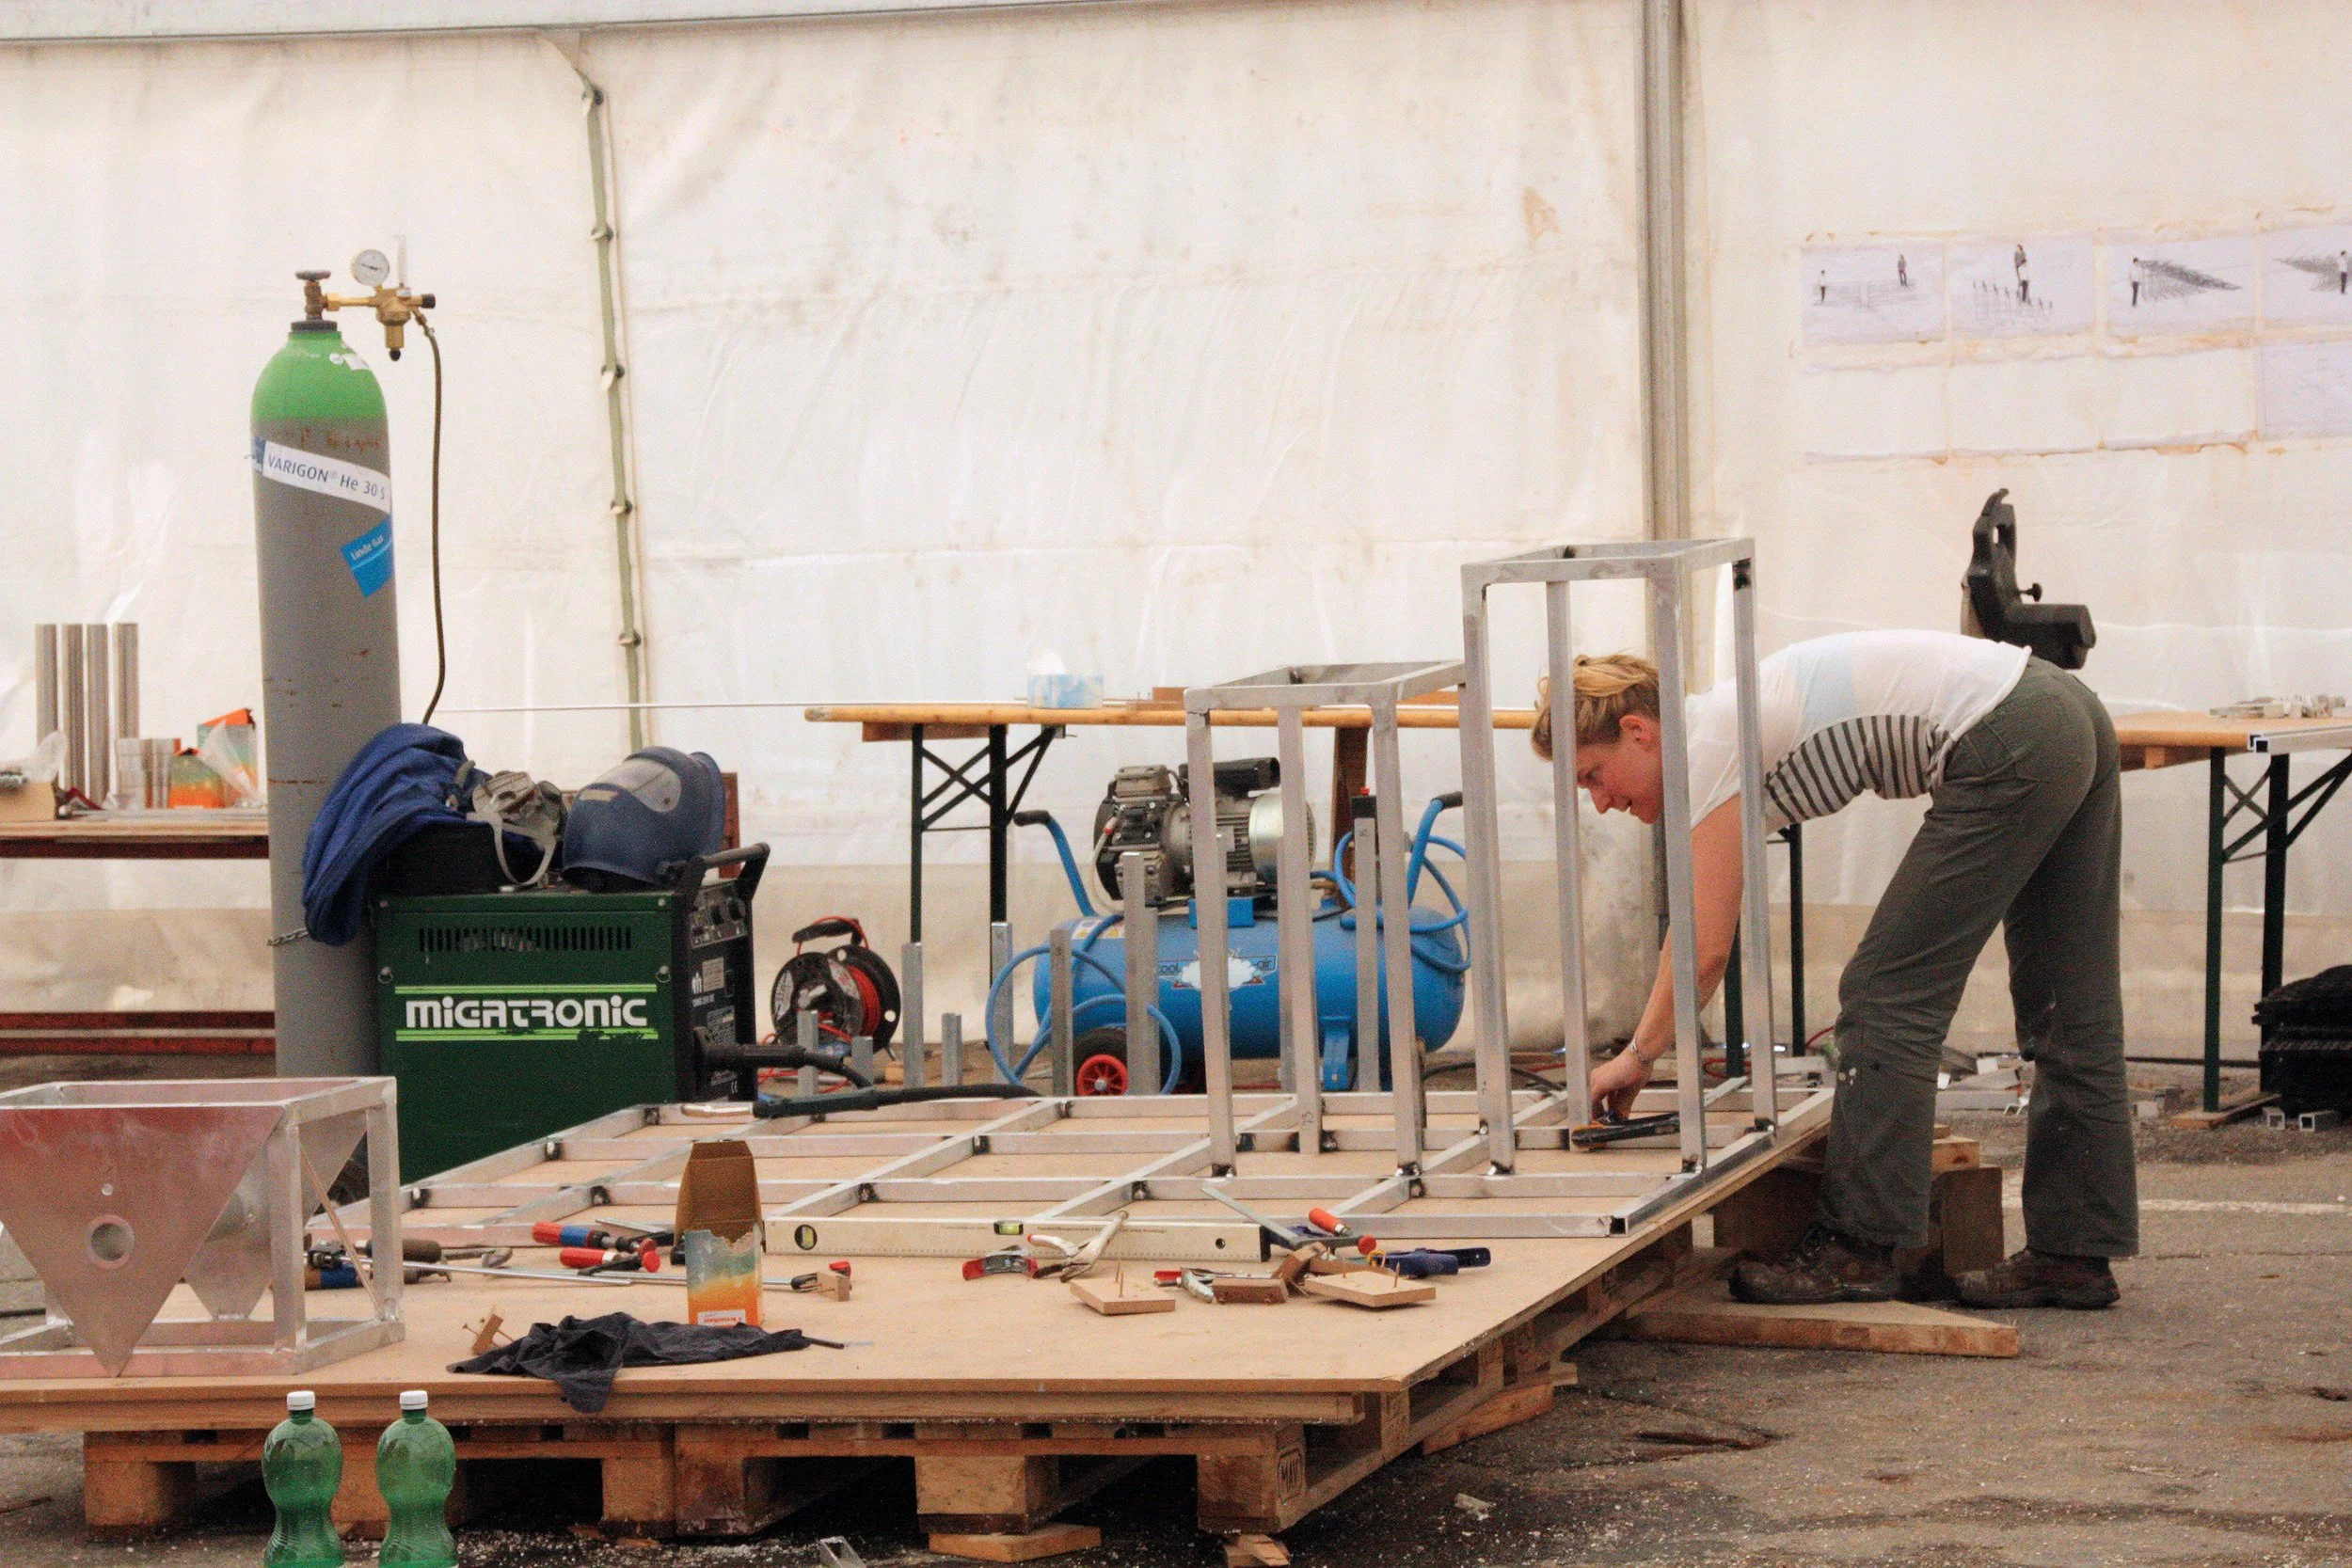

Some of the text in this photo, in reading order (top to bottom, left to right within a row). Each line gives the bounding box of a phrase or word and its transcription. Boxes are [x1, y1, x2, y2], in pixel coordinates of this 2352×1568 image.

[340, 474, 358, 491] He
[362, 481, 377, 497] 30
[380, 486, 386, 500] S
